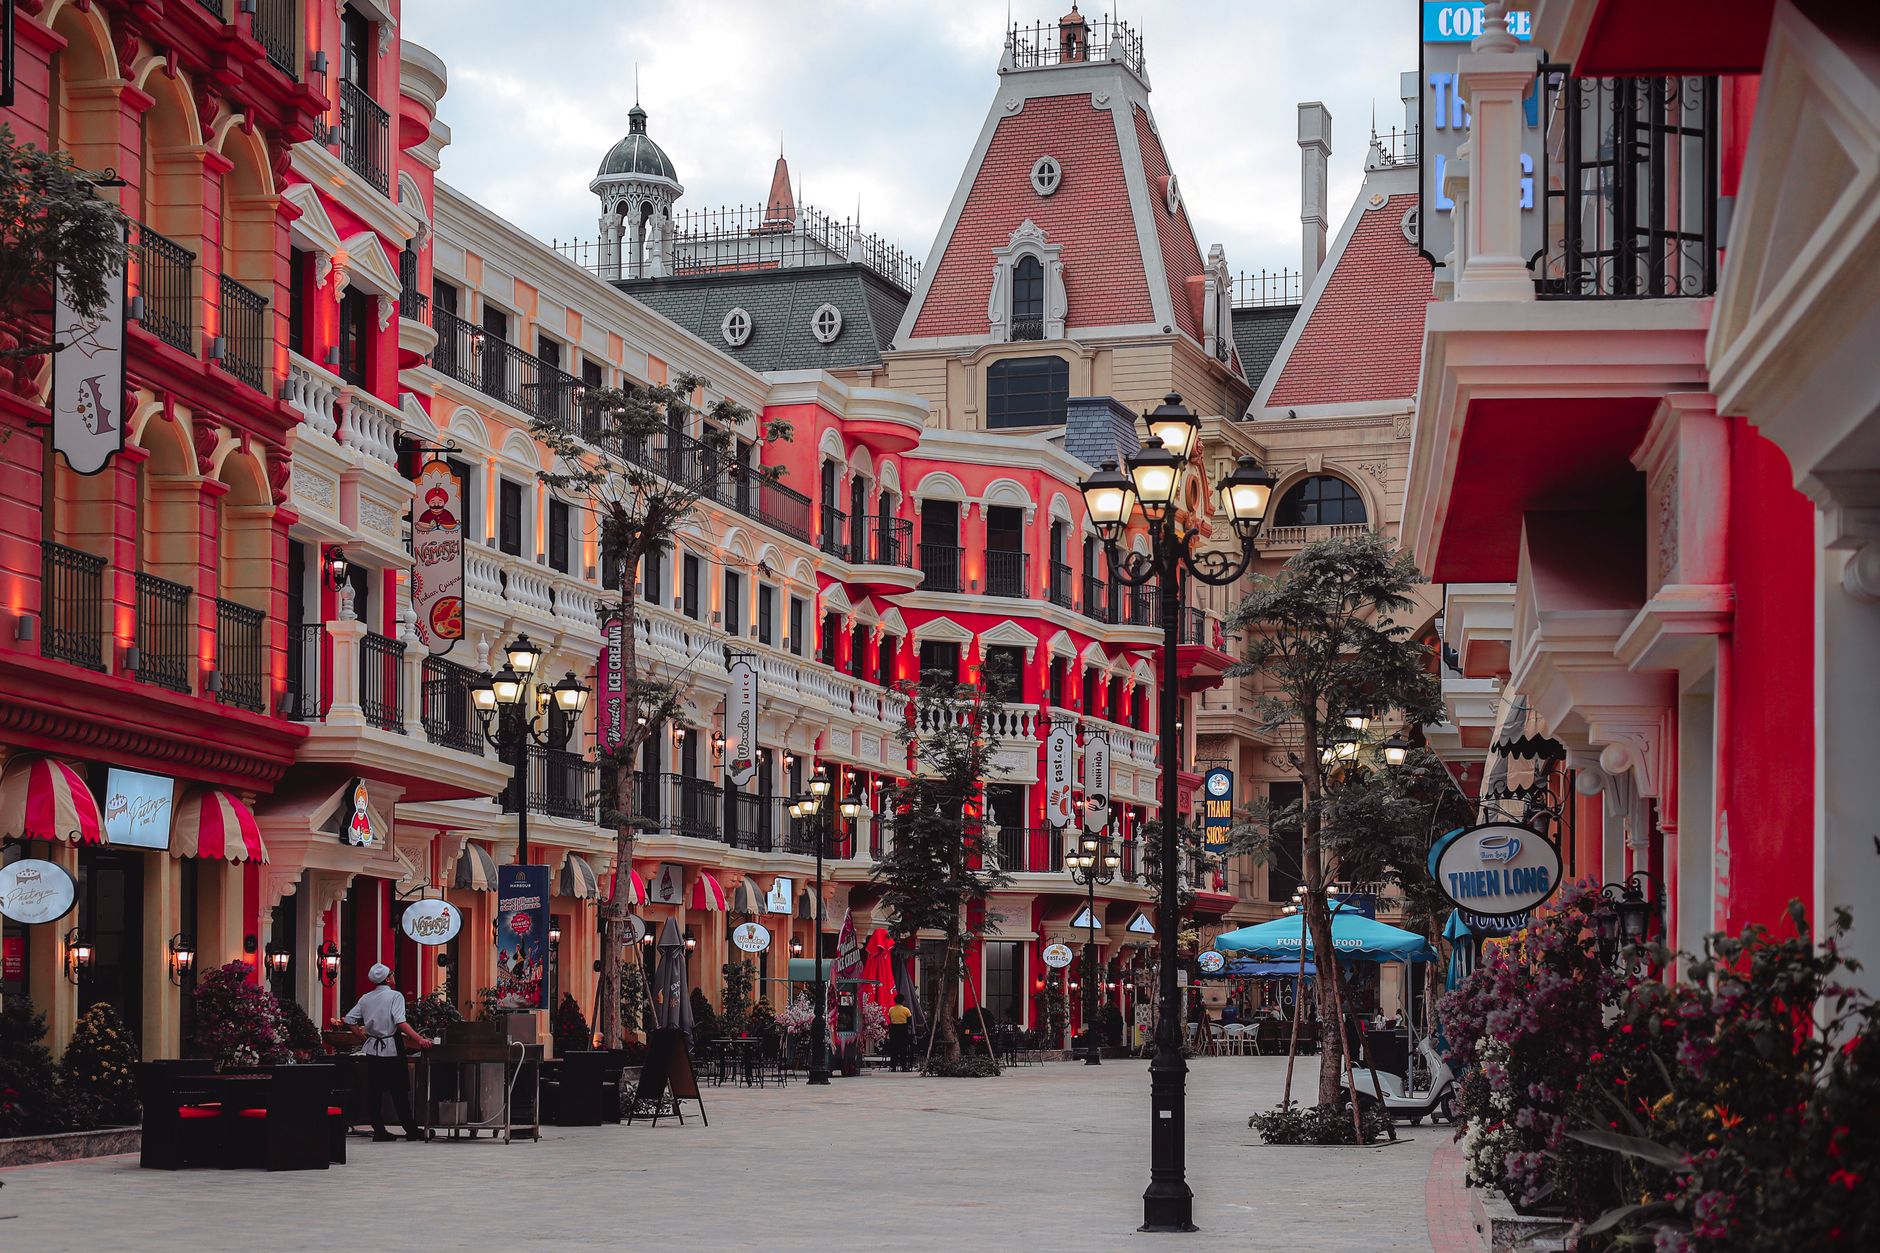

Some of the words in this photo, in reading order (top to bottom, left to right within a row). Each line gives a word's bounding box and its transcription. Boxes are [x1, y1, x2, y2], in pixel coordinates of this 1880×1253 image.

[1438, 7, 1531, 37] COFEE
[417, 590, 439, 606] Indian
[439, 576, 463, 593] Cuisine
[608, 626, 622, 670] CREAM
[608, 671, 622, 692] ICE
[742, 673, 751, 705] juice
[608, 697, 621, 746] Wonder
[737, 709, 750, 758] Wonder
[1053, 760, 1064, 782] Fast
[1206, 800, 1231, 818] THANH
[1448, 869, 1499, 898] THIEN
[1503, 866, 1549, 896] LONG
